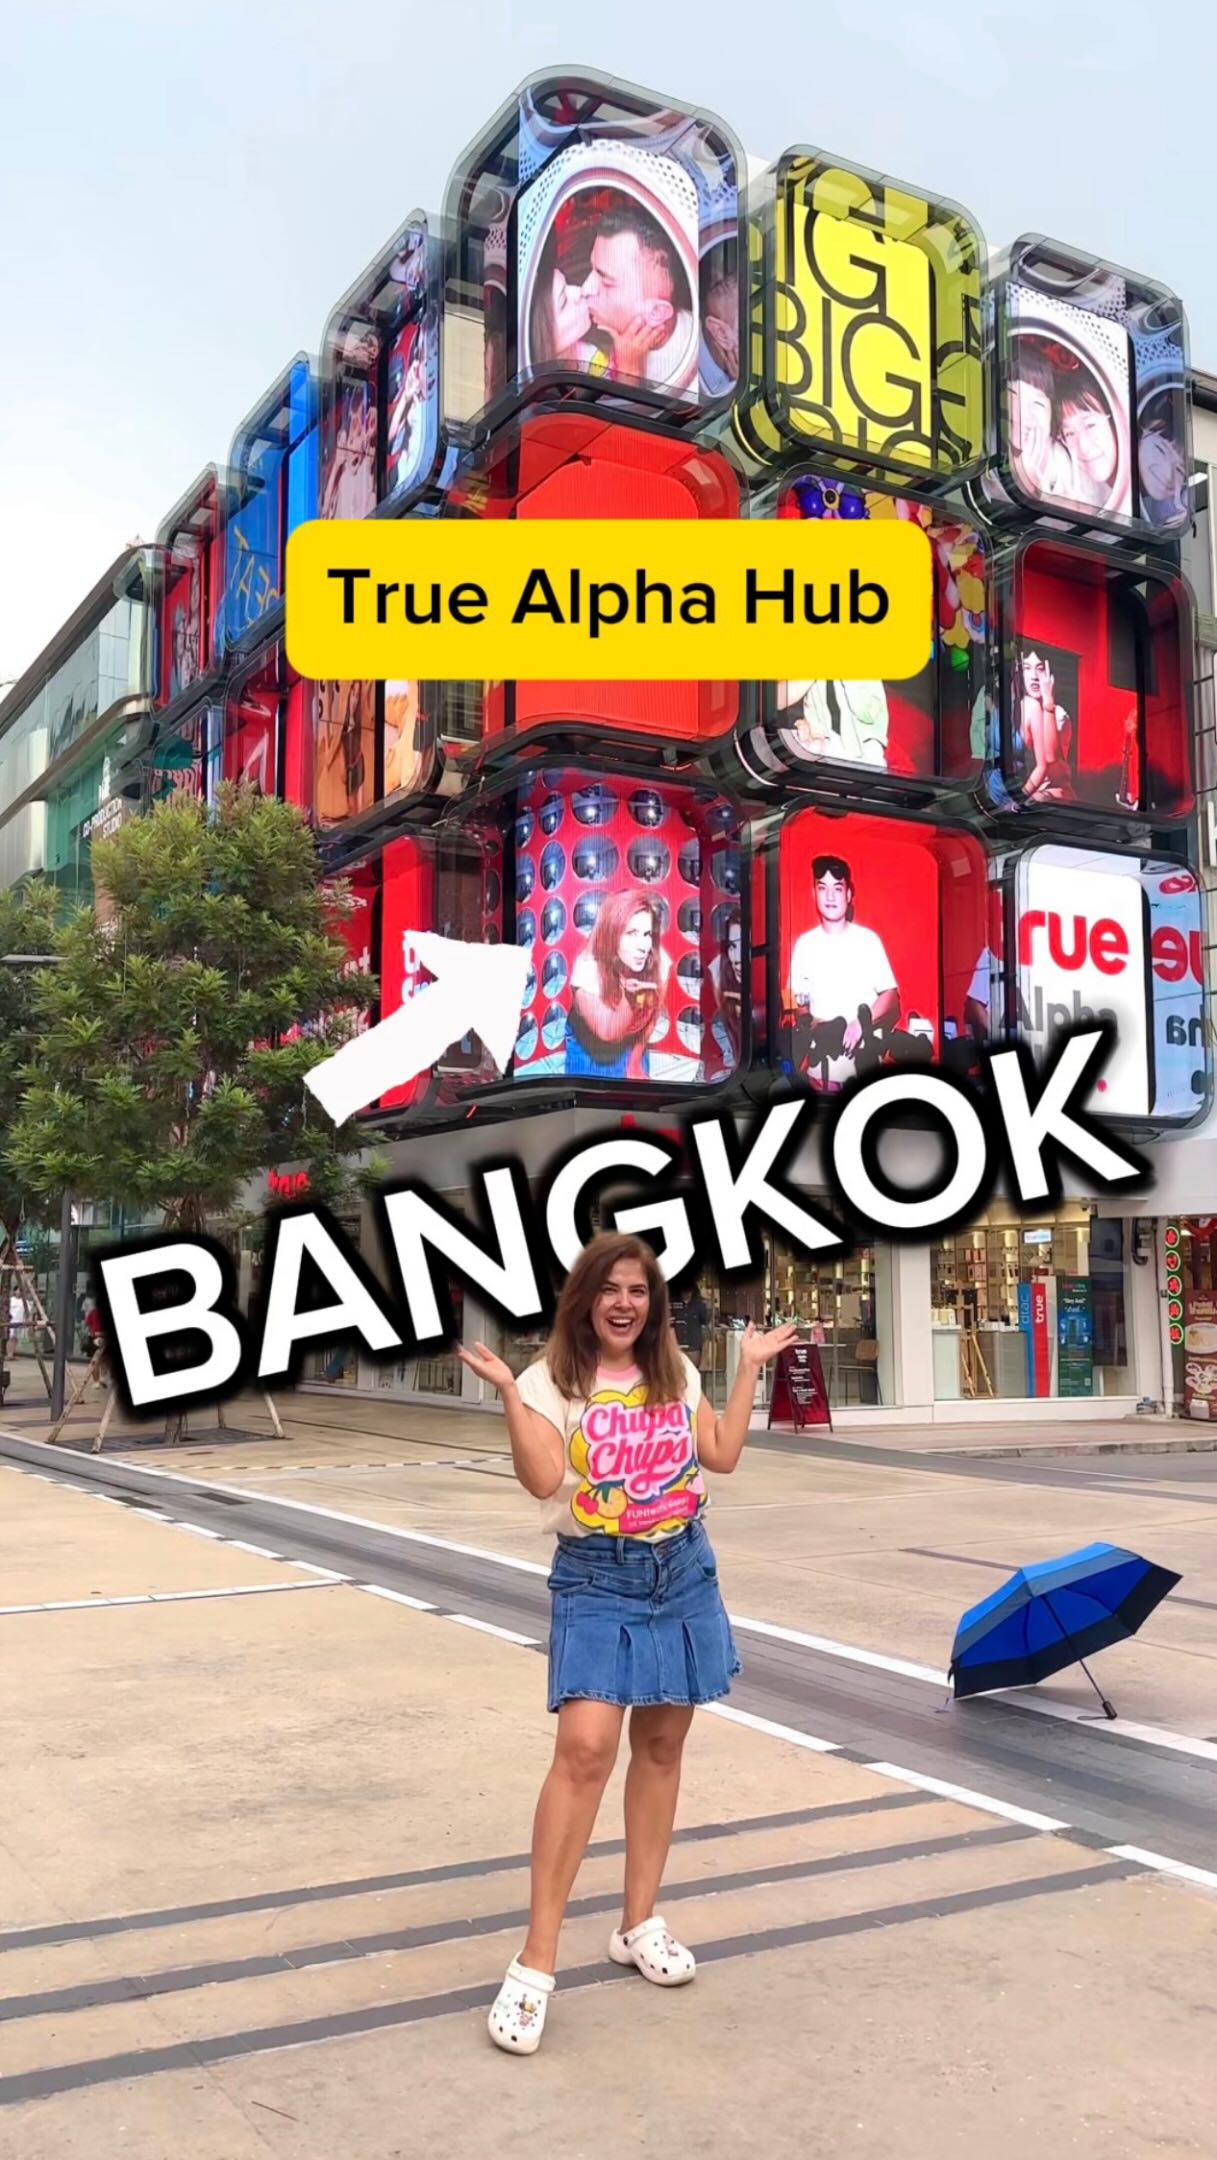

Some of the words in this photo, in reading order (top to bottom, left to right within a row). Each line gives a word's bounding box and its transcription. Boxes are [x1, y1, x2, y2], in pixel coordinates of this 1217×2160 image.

[776, 280, 922, 433] BIG
[1020, 1295, 1030, 1324] dtac
[1034, 1294, 1044, 1324] true
[587, 1403, 685, 1442] Chupa
[591, 1436, 689, 1494] Chups
